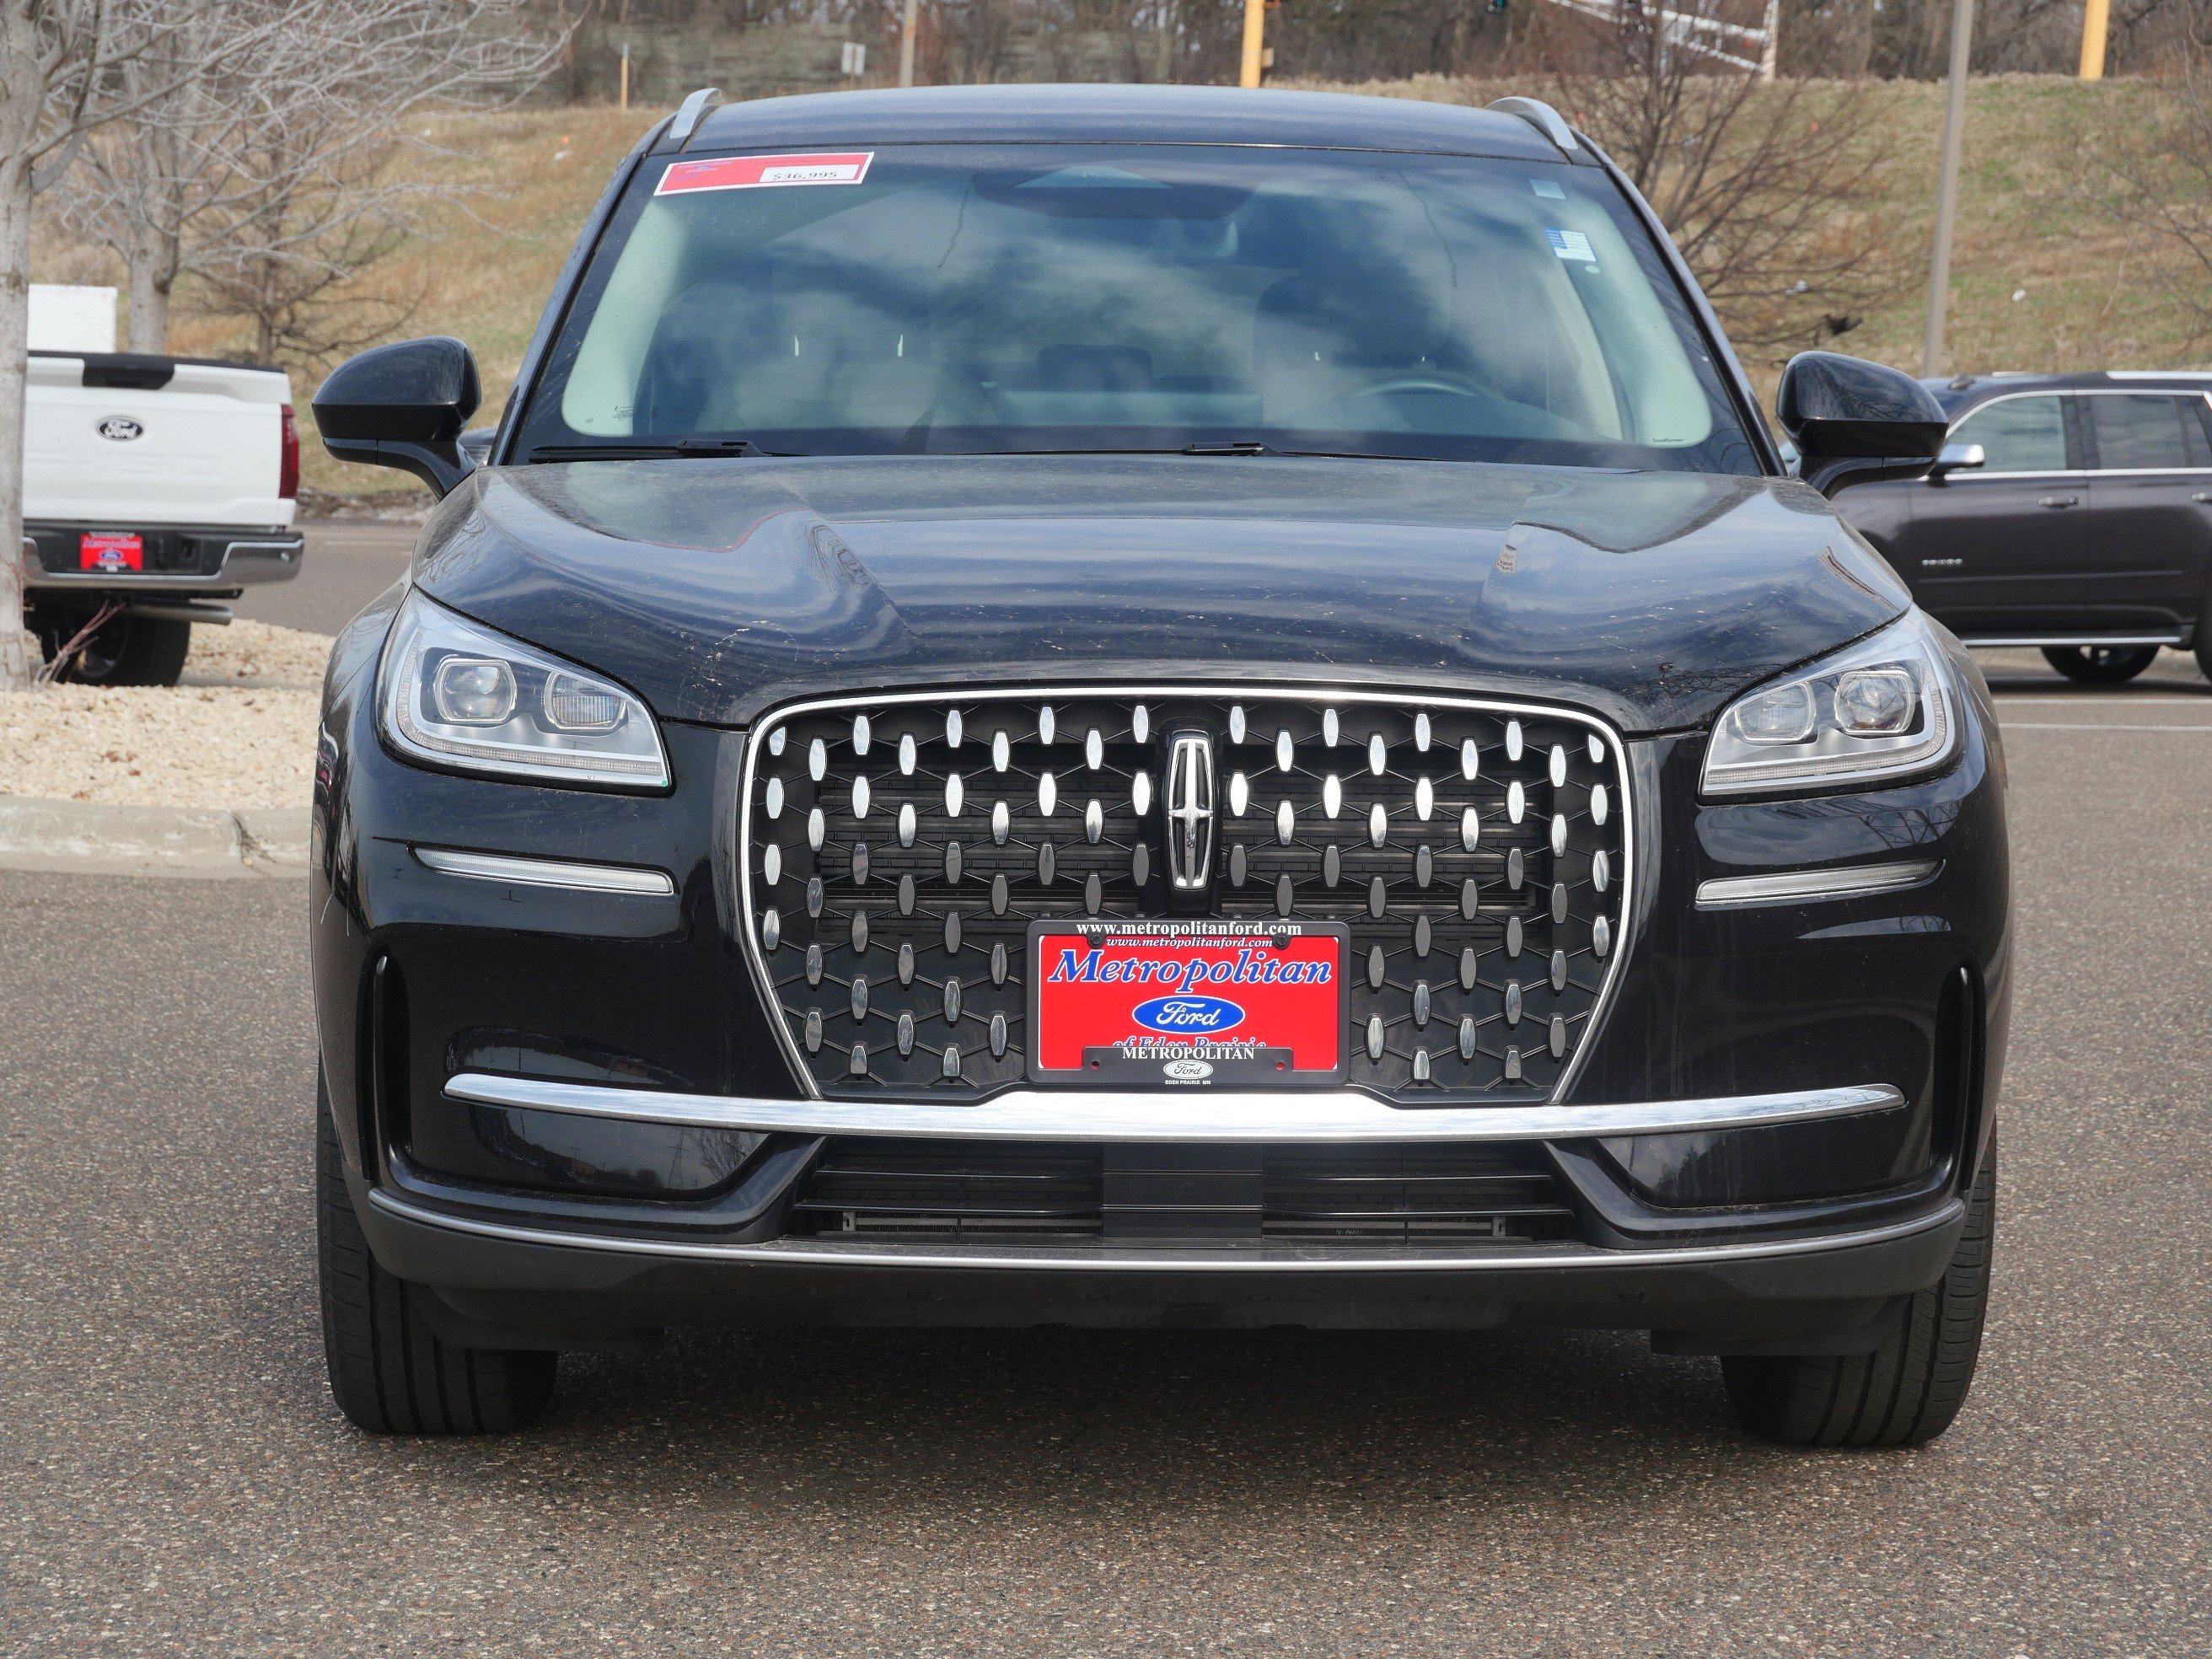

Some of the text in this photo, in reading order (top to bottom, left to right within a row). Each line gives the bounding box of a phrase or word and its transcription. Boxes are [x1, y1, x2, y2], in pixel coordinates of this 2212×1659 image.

[774, 171, 836, 180] $36,995
[1076, 921, 1302, 938] www.metropolitanford.com
[1106, 937, 1273, 949] www.metropolitanford.com
[1047, 949, 1332, 993] Metropolitan
[1157, 1001, 1221, 1025] Ford
[1123, 1047, 1254, 1059] METROPOLITAN
[1173, 1062, 1203, 1075] Ford
